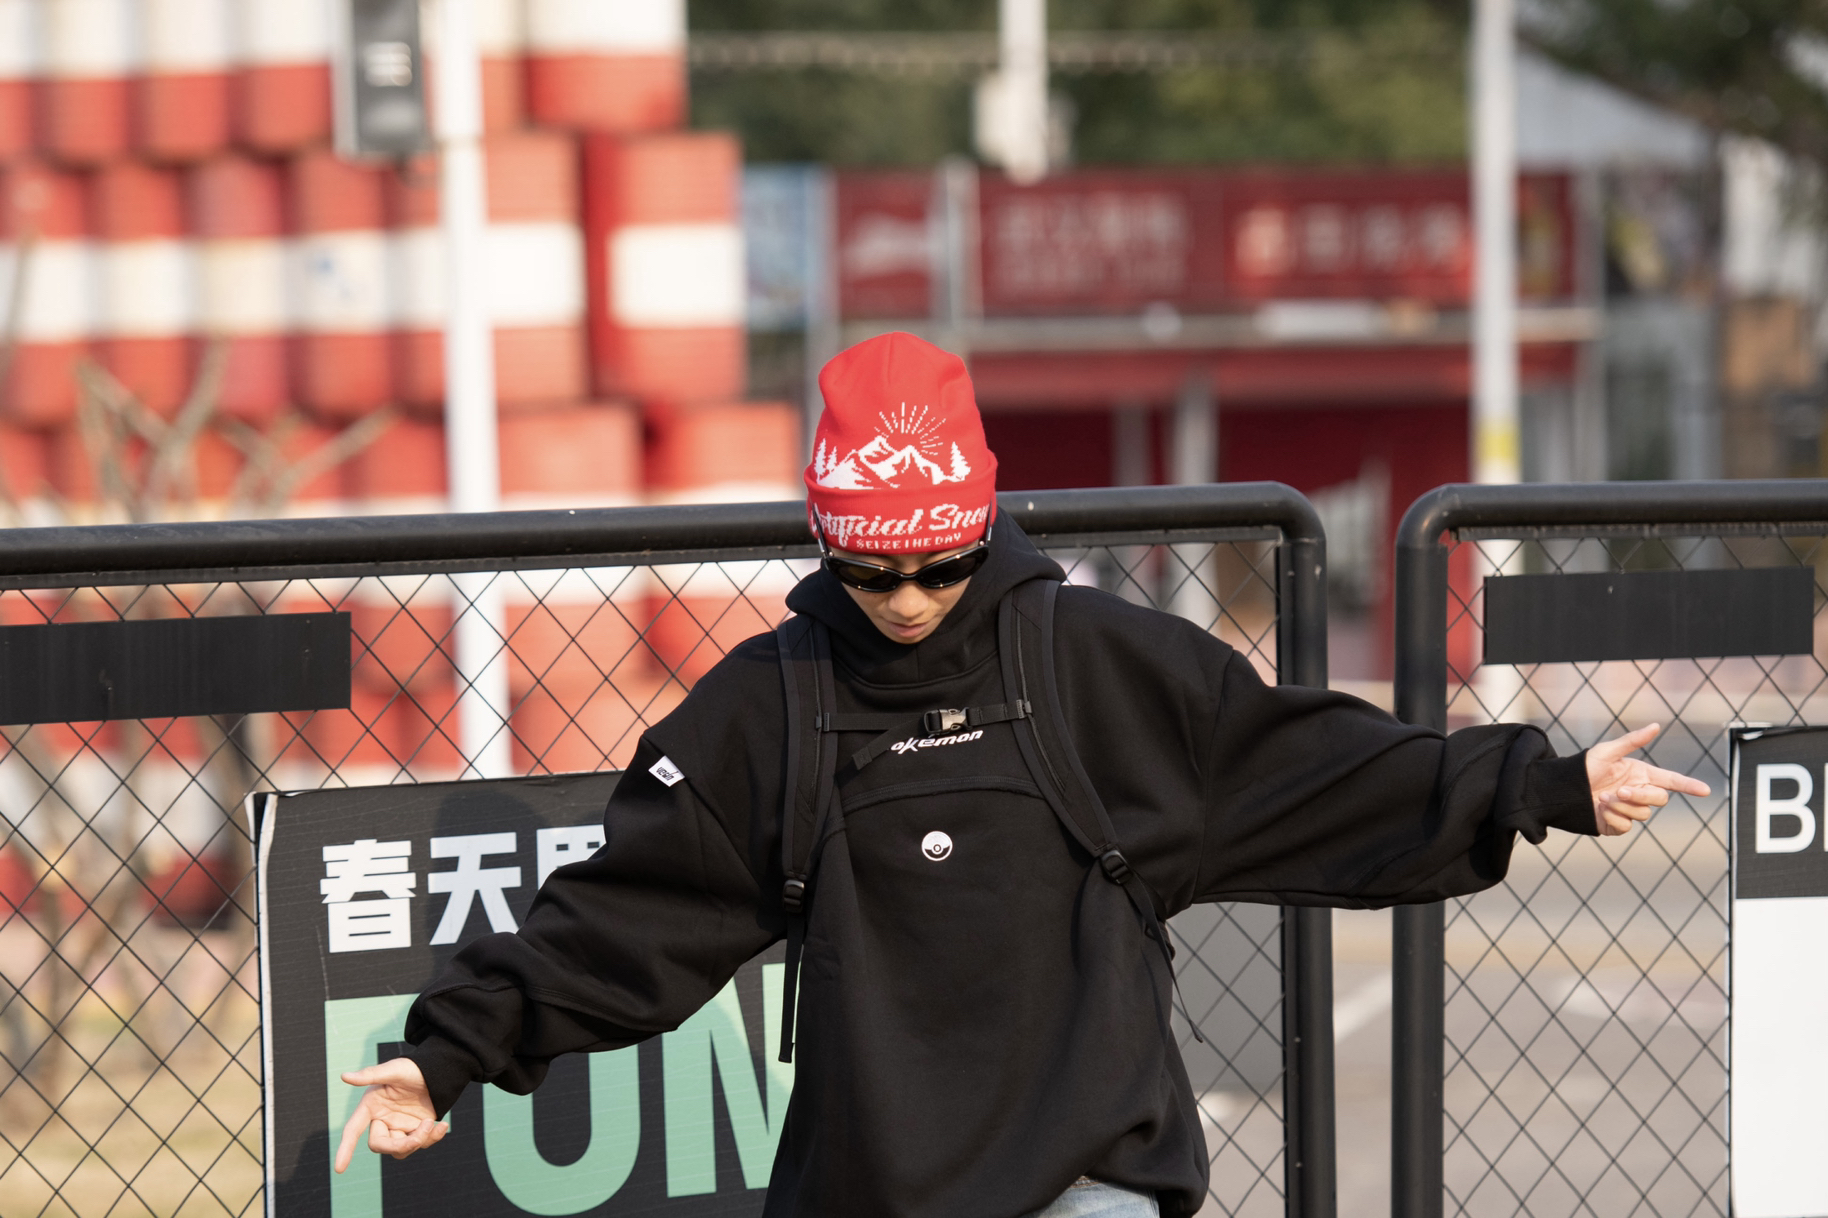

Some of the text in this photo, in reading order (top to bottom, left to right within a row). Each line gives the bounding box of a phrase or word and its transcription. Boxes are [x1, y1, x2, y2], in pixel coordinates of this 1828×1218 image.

[856, 538, 902, 550] SEIZE
[935, 532, 962, 546] DAY
[1755, 762, 1828, 854] B
